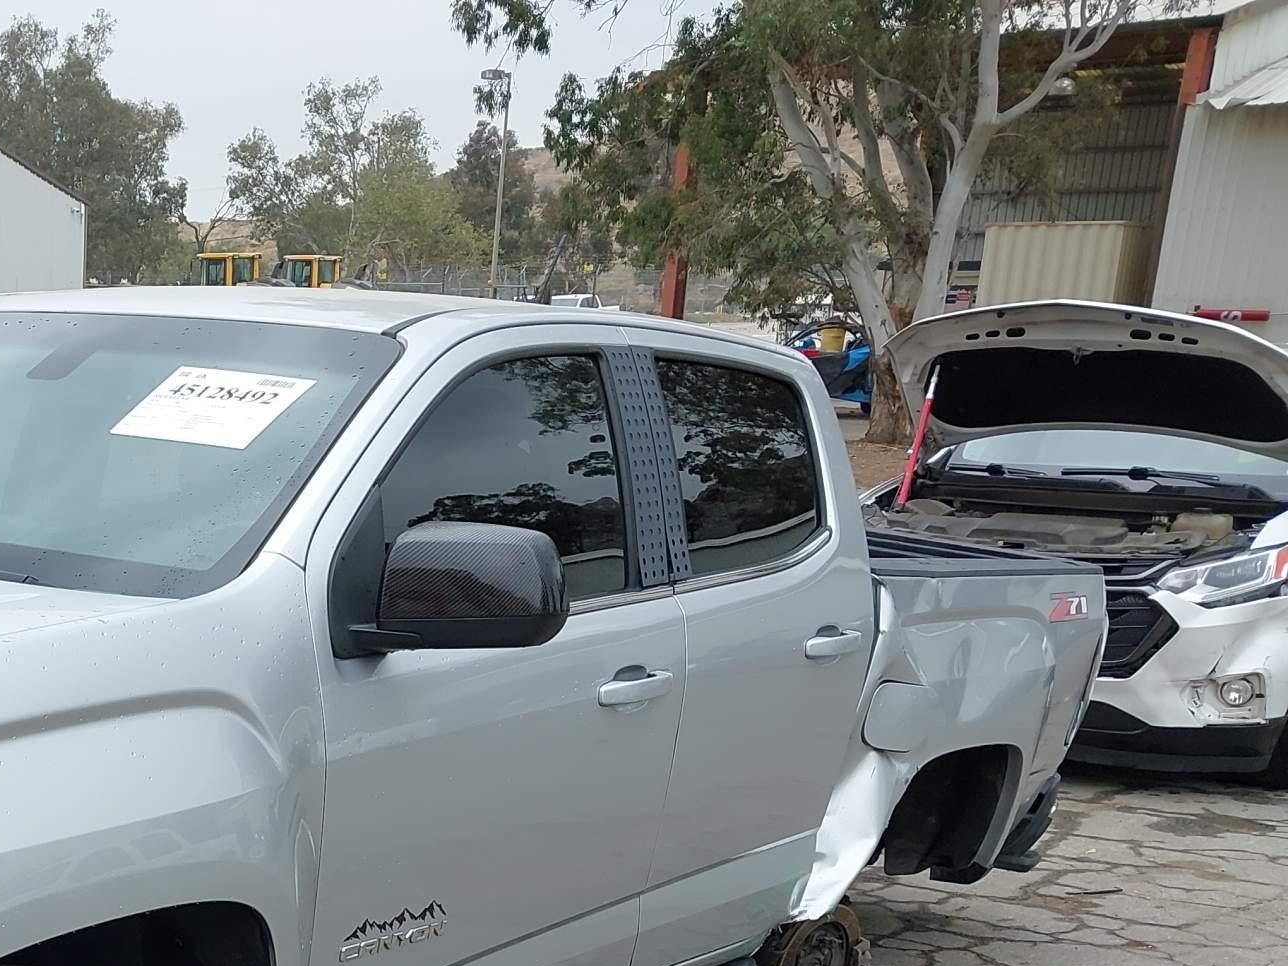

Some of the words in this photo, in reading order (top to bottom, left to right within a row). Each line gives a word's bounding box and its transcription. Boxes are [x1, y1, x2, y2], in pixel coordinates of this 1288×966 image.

[168, 382, 280, 405] 45128492
[1048, 592, 1088, 623] Z71
[338, 919, 448, 963] CANYON
